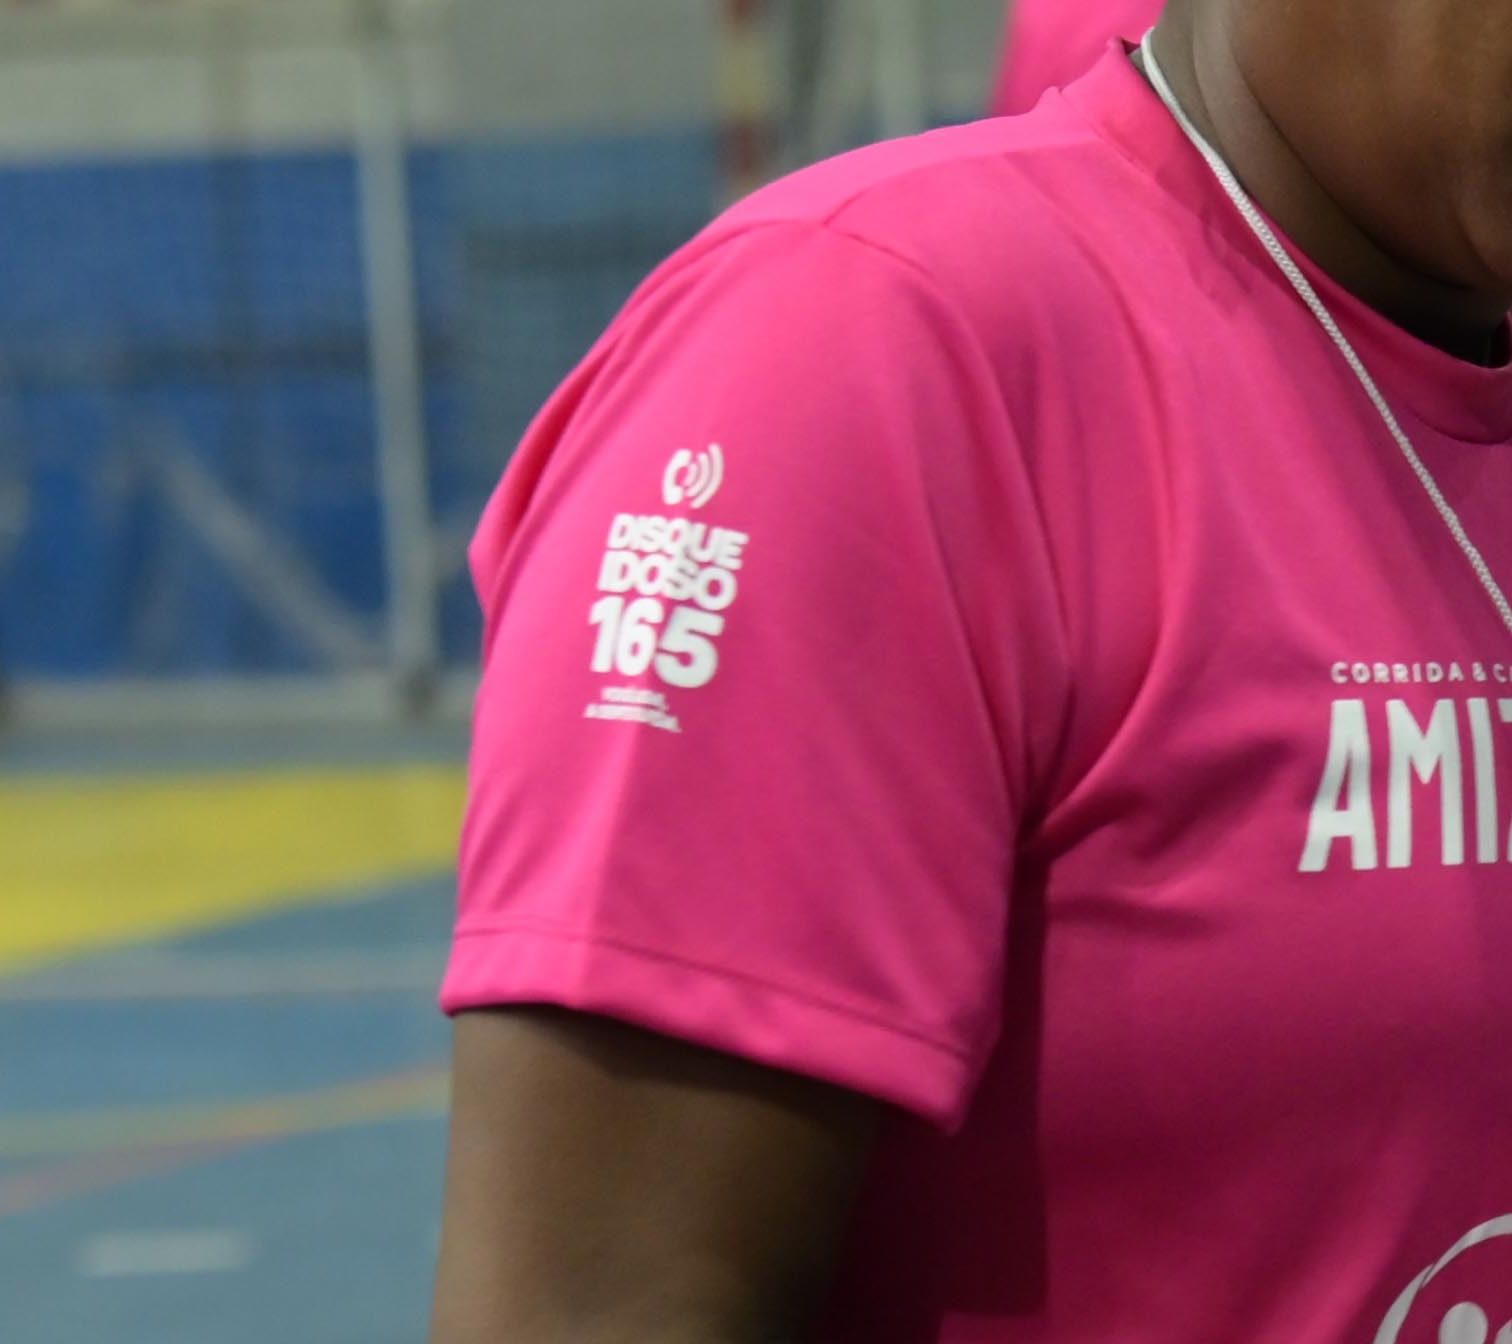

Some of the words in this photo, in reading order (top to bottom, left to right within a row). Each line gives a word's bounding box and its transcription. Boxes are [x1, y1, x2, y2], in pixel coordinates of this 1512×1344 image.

[607, 513, 749, 570] DISQUE
[597, 551, 738, 611] IDOSO
[589, 596, 725, 689] 165
[1331, 661, 1463, 685] CORRIDA
[1471, 661, 1487, 682] &
